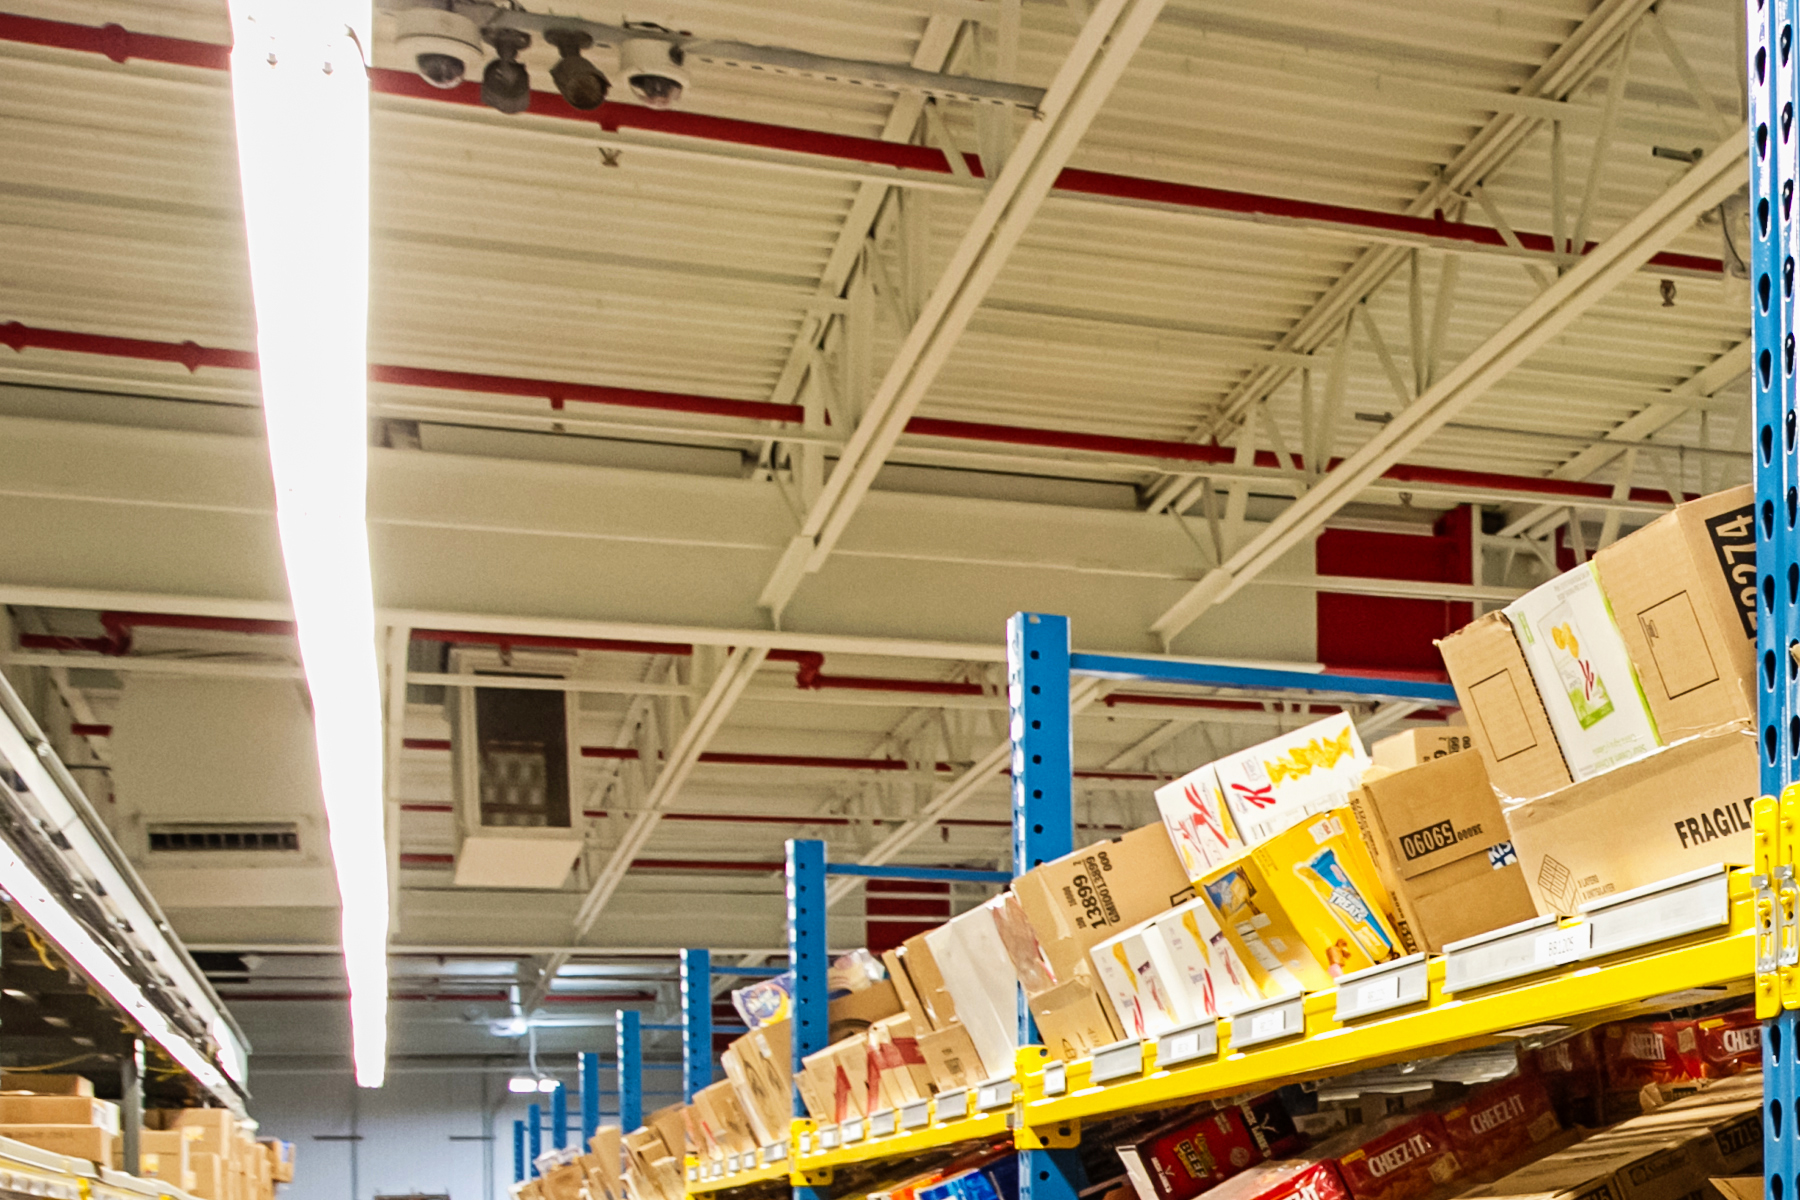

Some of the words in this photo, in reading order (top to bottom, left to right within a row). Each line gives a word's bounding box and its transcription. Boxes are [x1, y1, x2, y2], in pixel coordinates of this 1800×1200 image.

[1073, 875, 1107, 930] 13899
[1470, 1094, 1525, 1135] CHEEZ-IT
[1367, 1134, 1427, 1178] CHEEZ-IT
